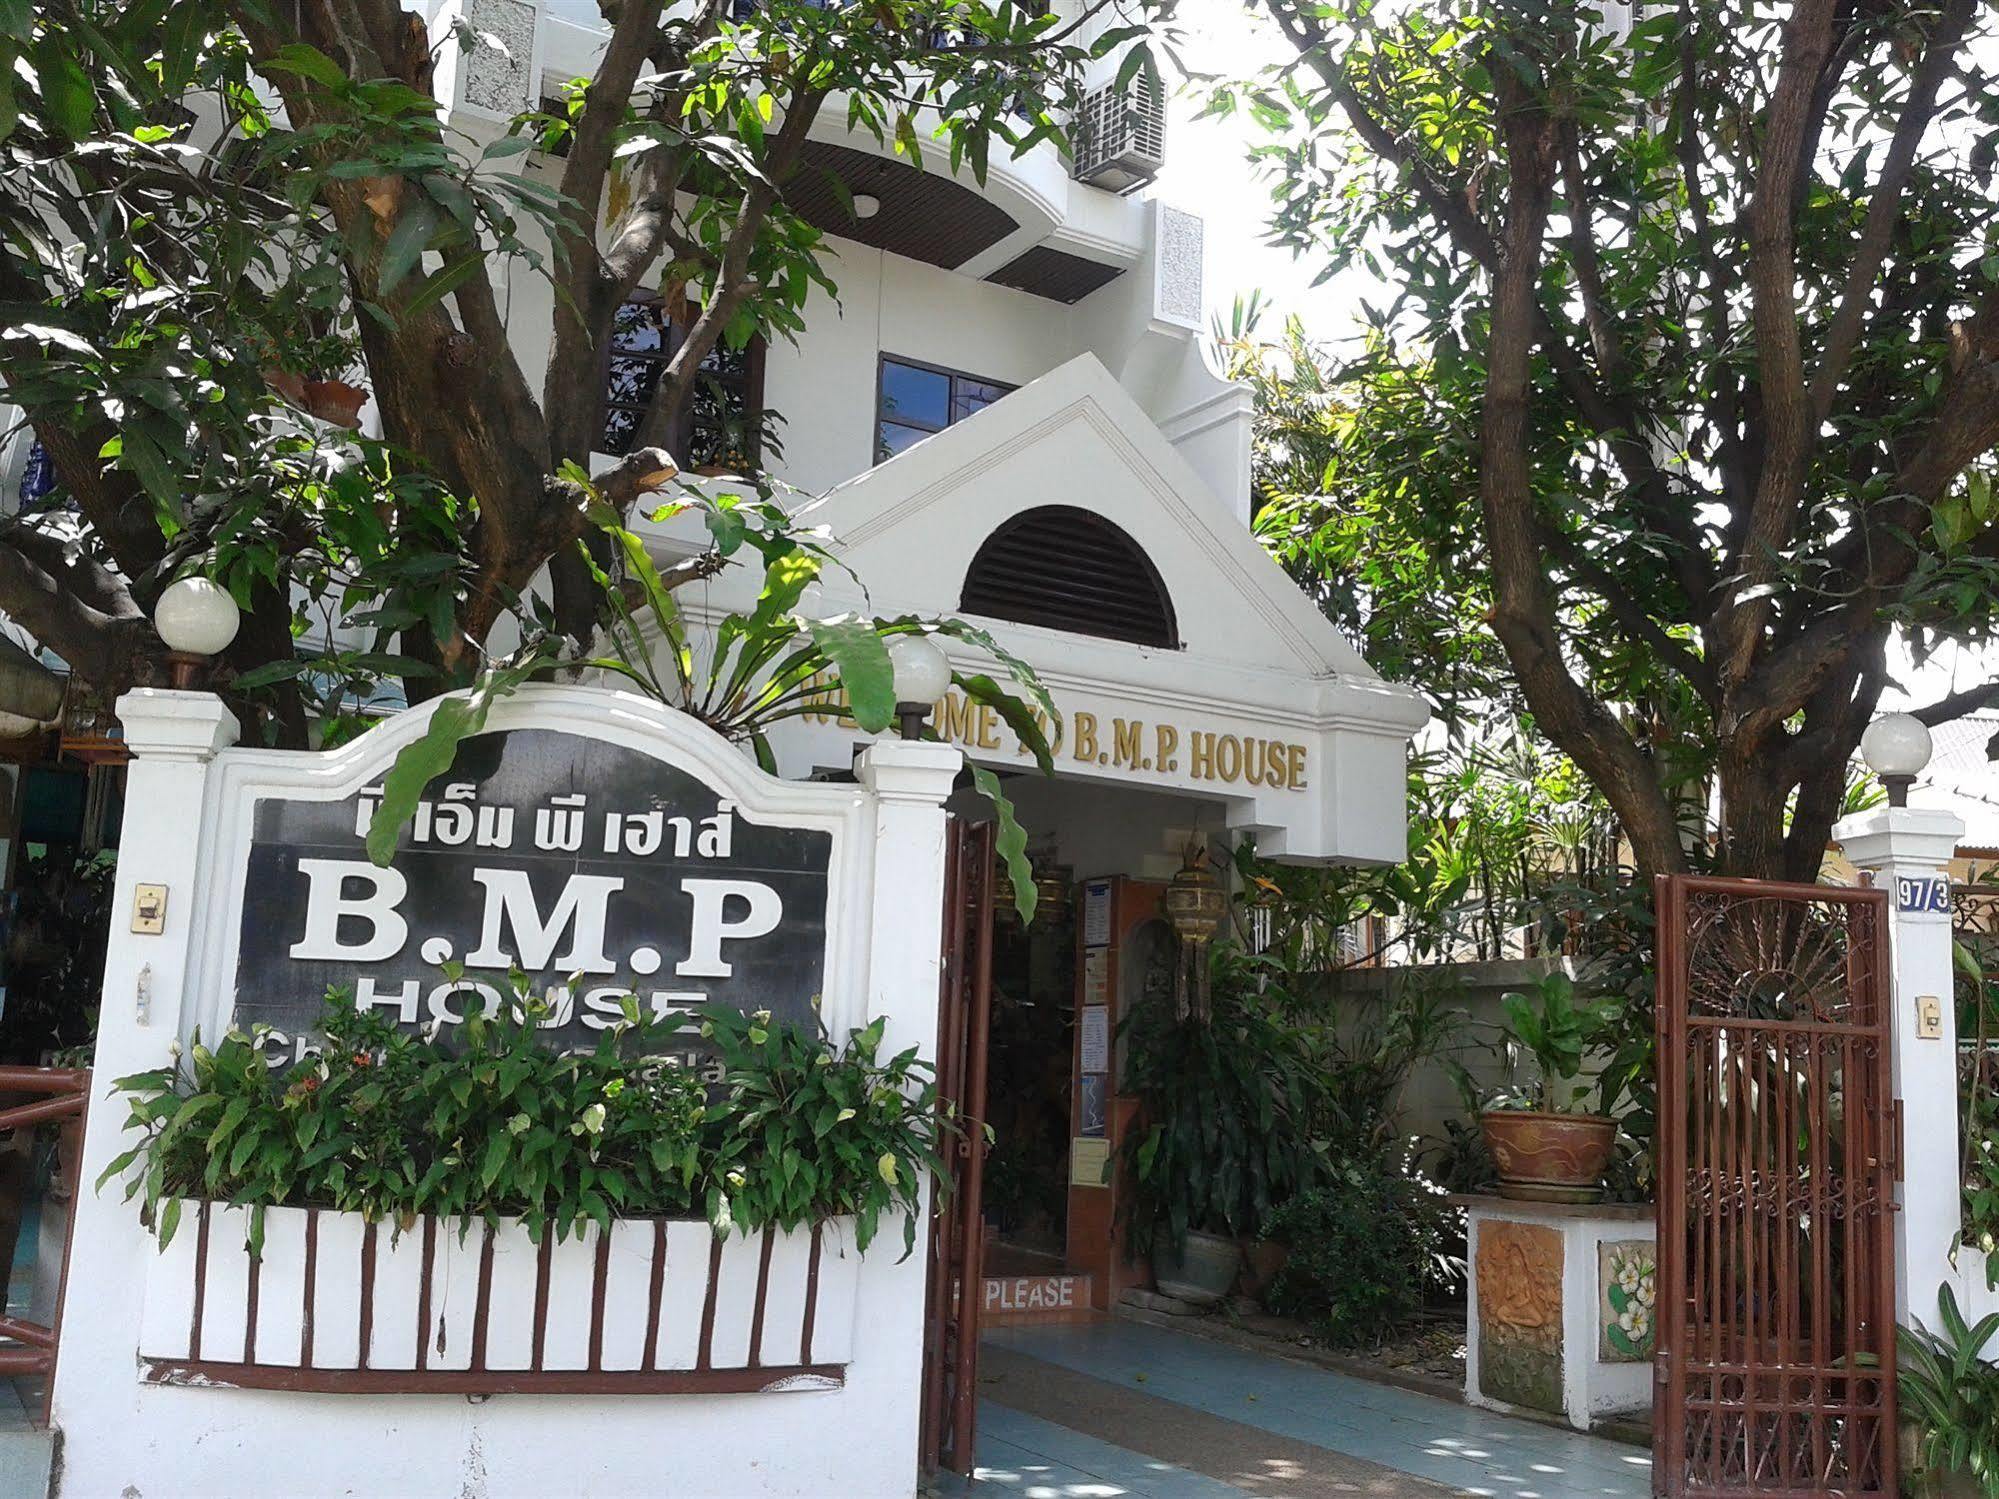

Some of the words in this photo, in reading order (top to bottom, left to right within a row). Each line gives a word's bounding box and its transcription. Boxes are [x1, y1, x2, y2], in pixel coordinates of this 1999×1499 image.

[1073, 711, 1178, 772] B.M.P.
[1190, 731, 1308, 792] HOUSE
[289, 857, 784, 978] B.M.P
[1899, 879, 1949, 911] 97/3
[354, 977, 708, 1034] HOUSE
[985, 1277, 1074, 1310] PLEASE
